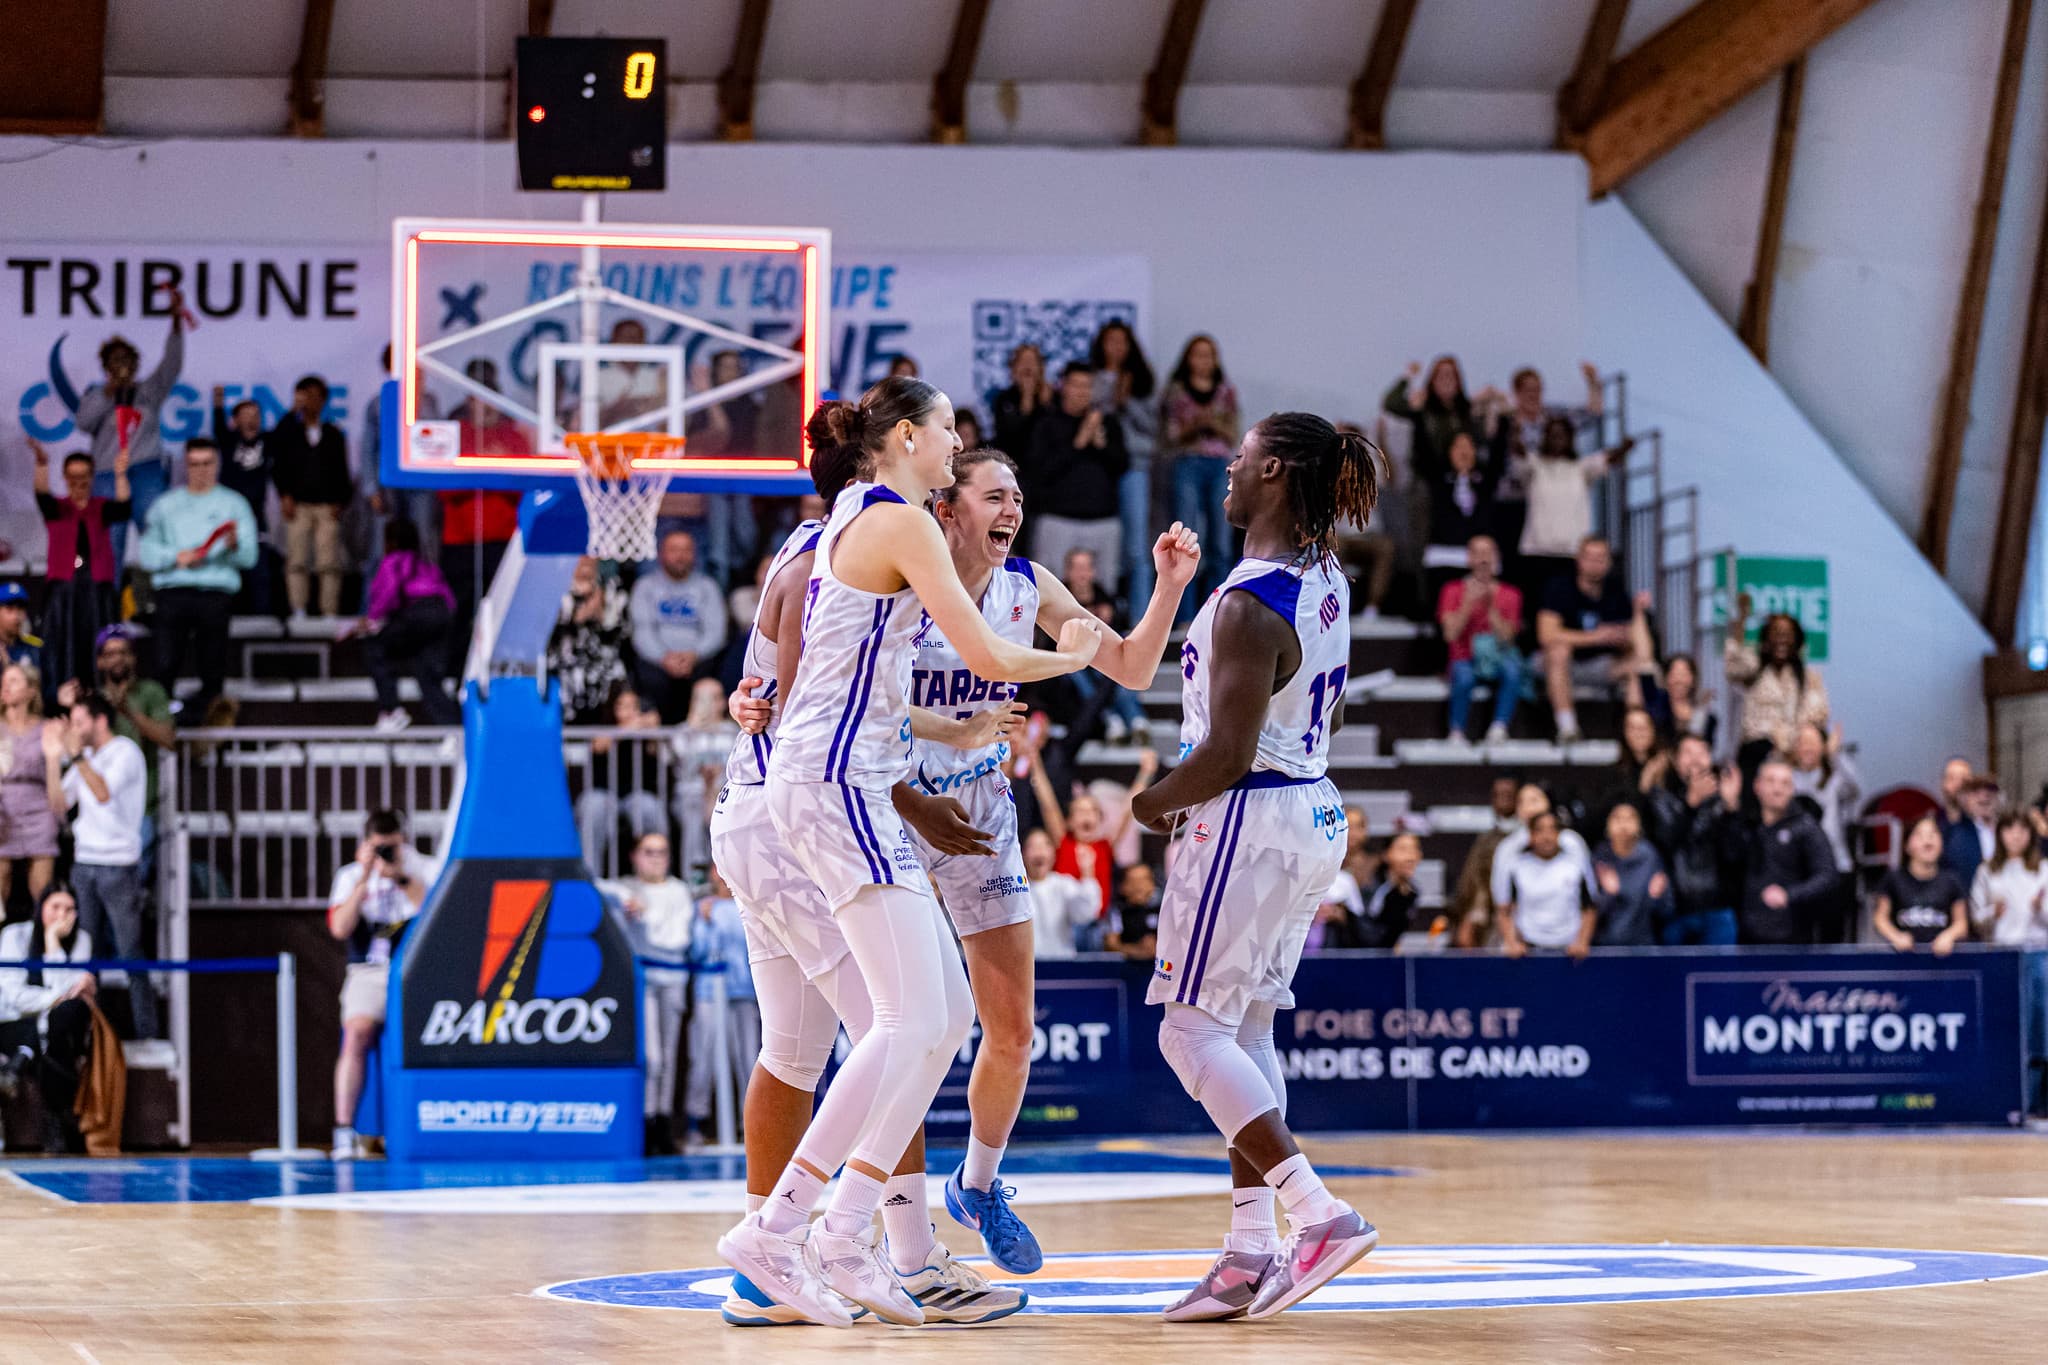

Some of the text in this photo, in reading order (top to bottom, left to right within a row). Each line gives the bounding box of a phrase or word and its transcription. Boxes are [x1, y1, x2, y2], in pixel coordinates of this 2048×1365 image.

[6, 258, 358, 319] TRIBUNE
[526, 262, 702, 308] REOINS
[979, 882, 1012, 894] lourdes
[986, 875, 1014, 886] tarbes
[420, 998, 618, 1045] BARCOS
[1294, 1007, 1524, 1040] FOIE GRAS ET
[1703, 1012, 1967, 1054] MONTFORT
[1389, 1047, 1435, 1079] DE
[1440, 1044, 1591, 1079] CANARD
